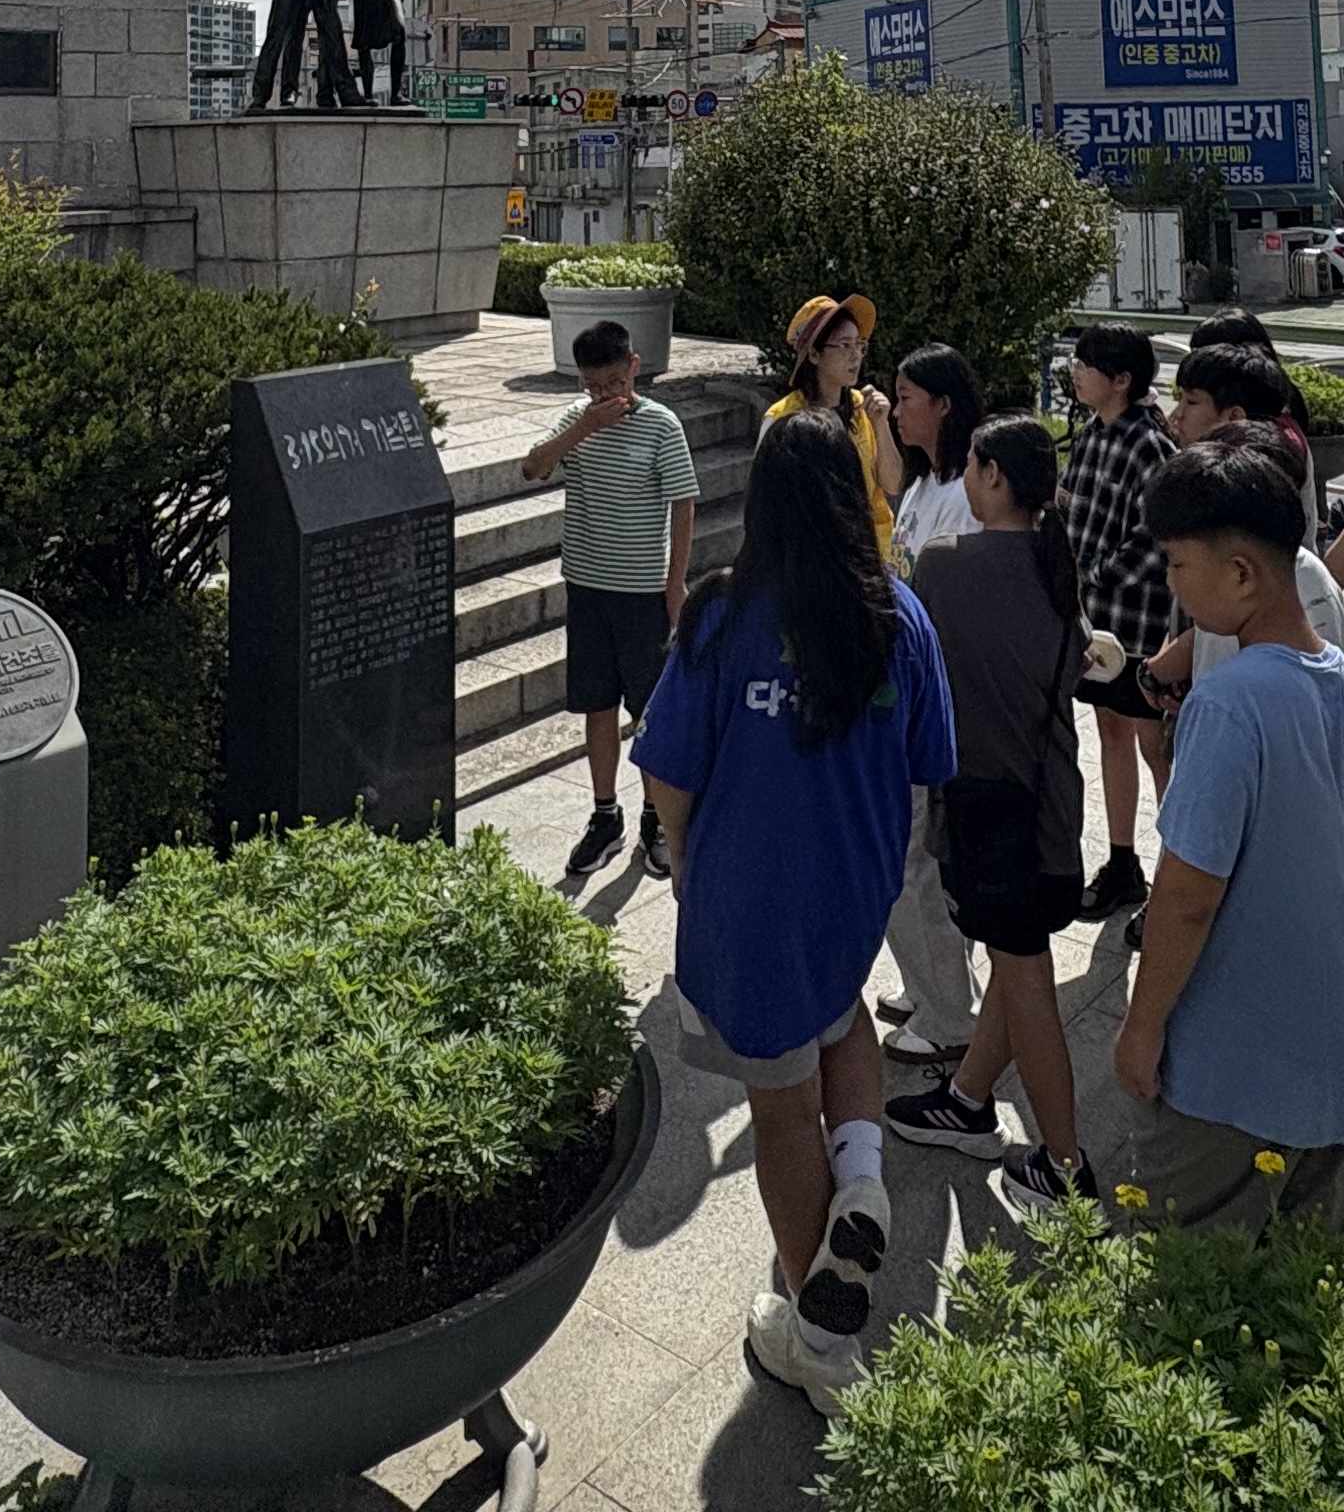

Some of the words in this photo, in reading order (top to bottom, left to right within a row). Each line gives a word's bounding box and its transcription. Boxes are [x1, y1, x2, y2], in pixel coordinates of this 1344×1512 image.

[869, 9, 926, 57] 에스모터스
[1119, 43, 1159, 66] (인증
[1163, 42, 1221, 65] 중고차)
[671, 98, 684, 110] 50
[1062, 106, 1153, 145] 중고차
[1163, 103, 1283, 143] 매매단지
[1296, 102, 1312, 180] 직영중고차
[360, 410, 425, 452] 기념탑
